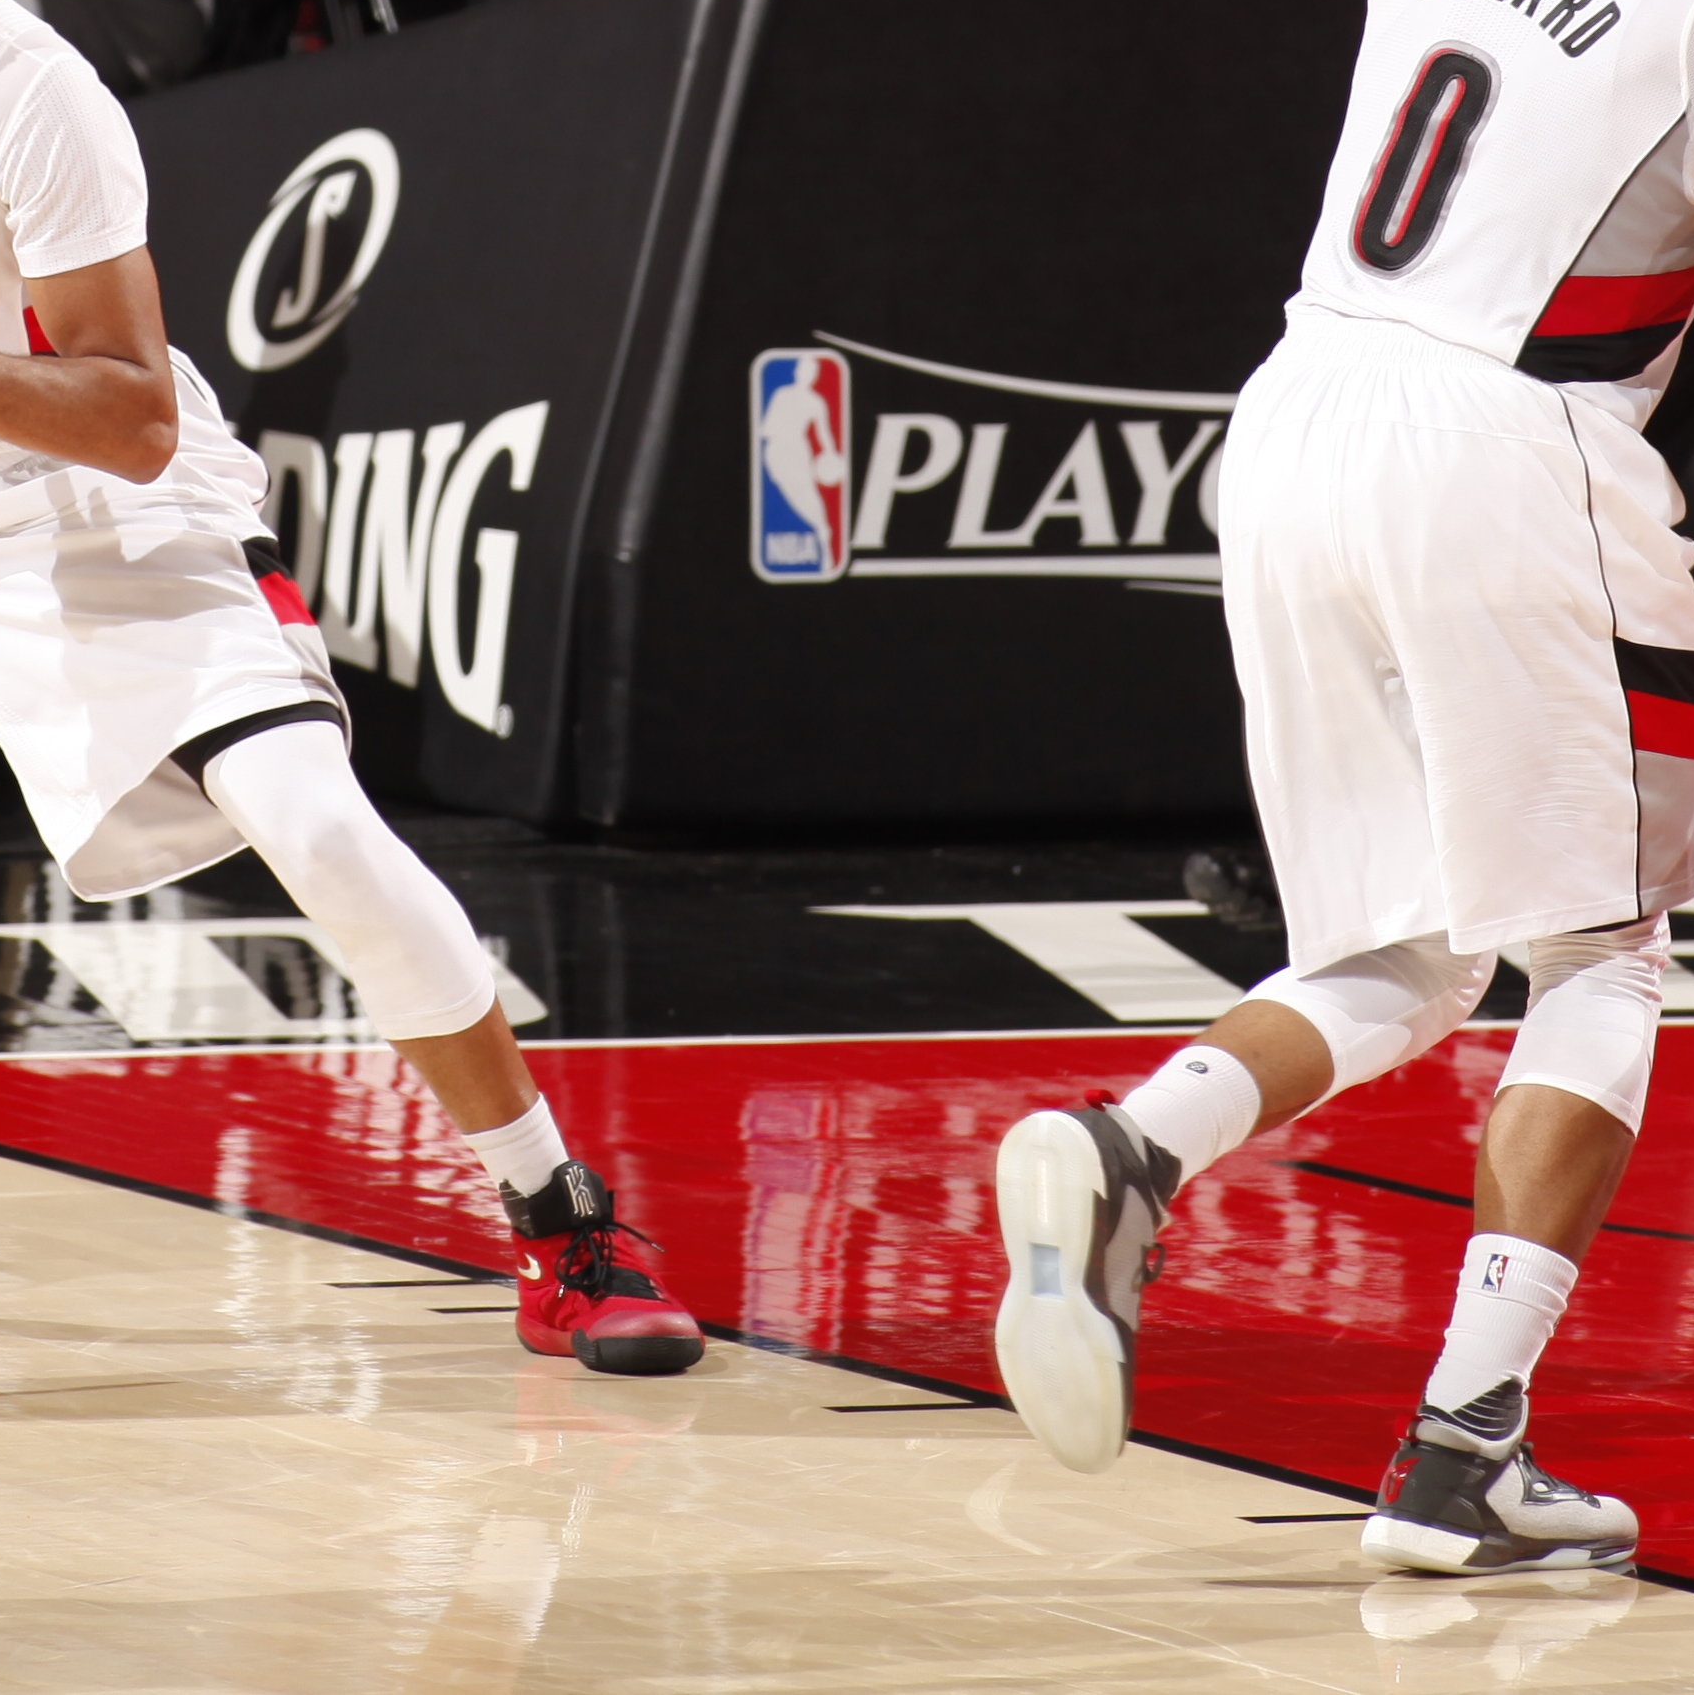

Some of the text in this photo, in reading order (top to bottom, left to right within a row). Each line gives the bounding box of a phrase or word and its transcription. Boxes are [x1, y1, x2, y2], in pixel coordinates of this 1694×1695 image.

[1349, 40, 1501, 278] 0
[767, 532, 819, 565] NBA
[852, 414, 1224, 550] PLAY
